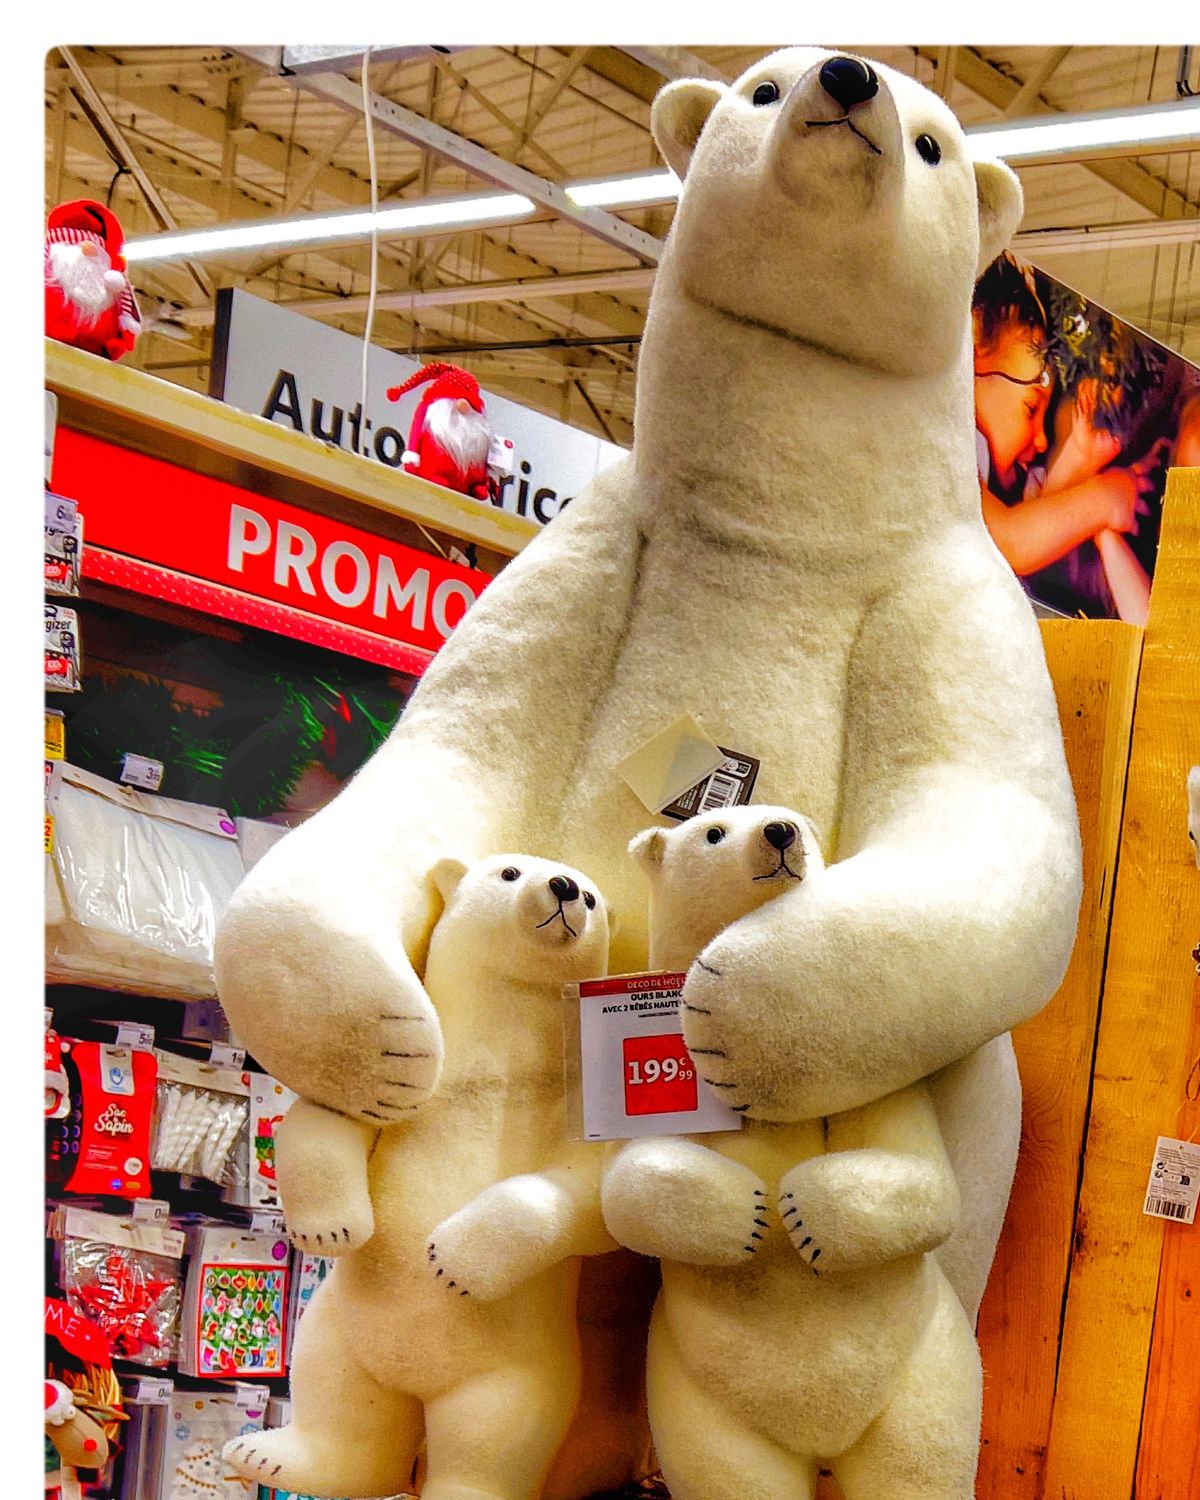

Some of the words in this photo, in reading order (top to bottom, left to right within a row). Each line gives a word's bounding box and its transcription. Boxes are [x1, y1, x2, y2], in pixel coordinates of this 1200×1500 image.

[260, 368, 406, 467] Auto
[498, 460, 576, 526] ric
[227, 503, 478, 640] PROMO
[602, 1005, 623, 1014] AVEC
[653, 1000, 682, 1009] HAUTE
[630, 991, 655, 1001] OURS
[655, 990, 684, 1000] BLANC
[94, 1113, 134, 1137] Sapin
